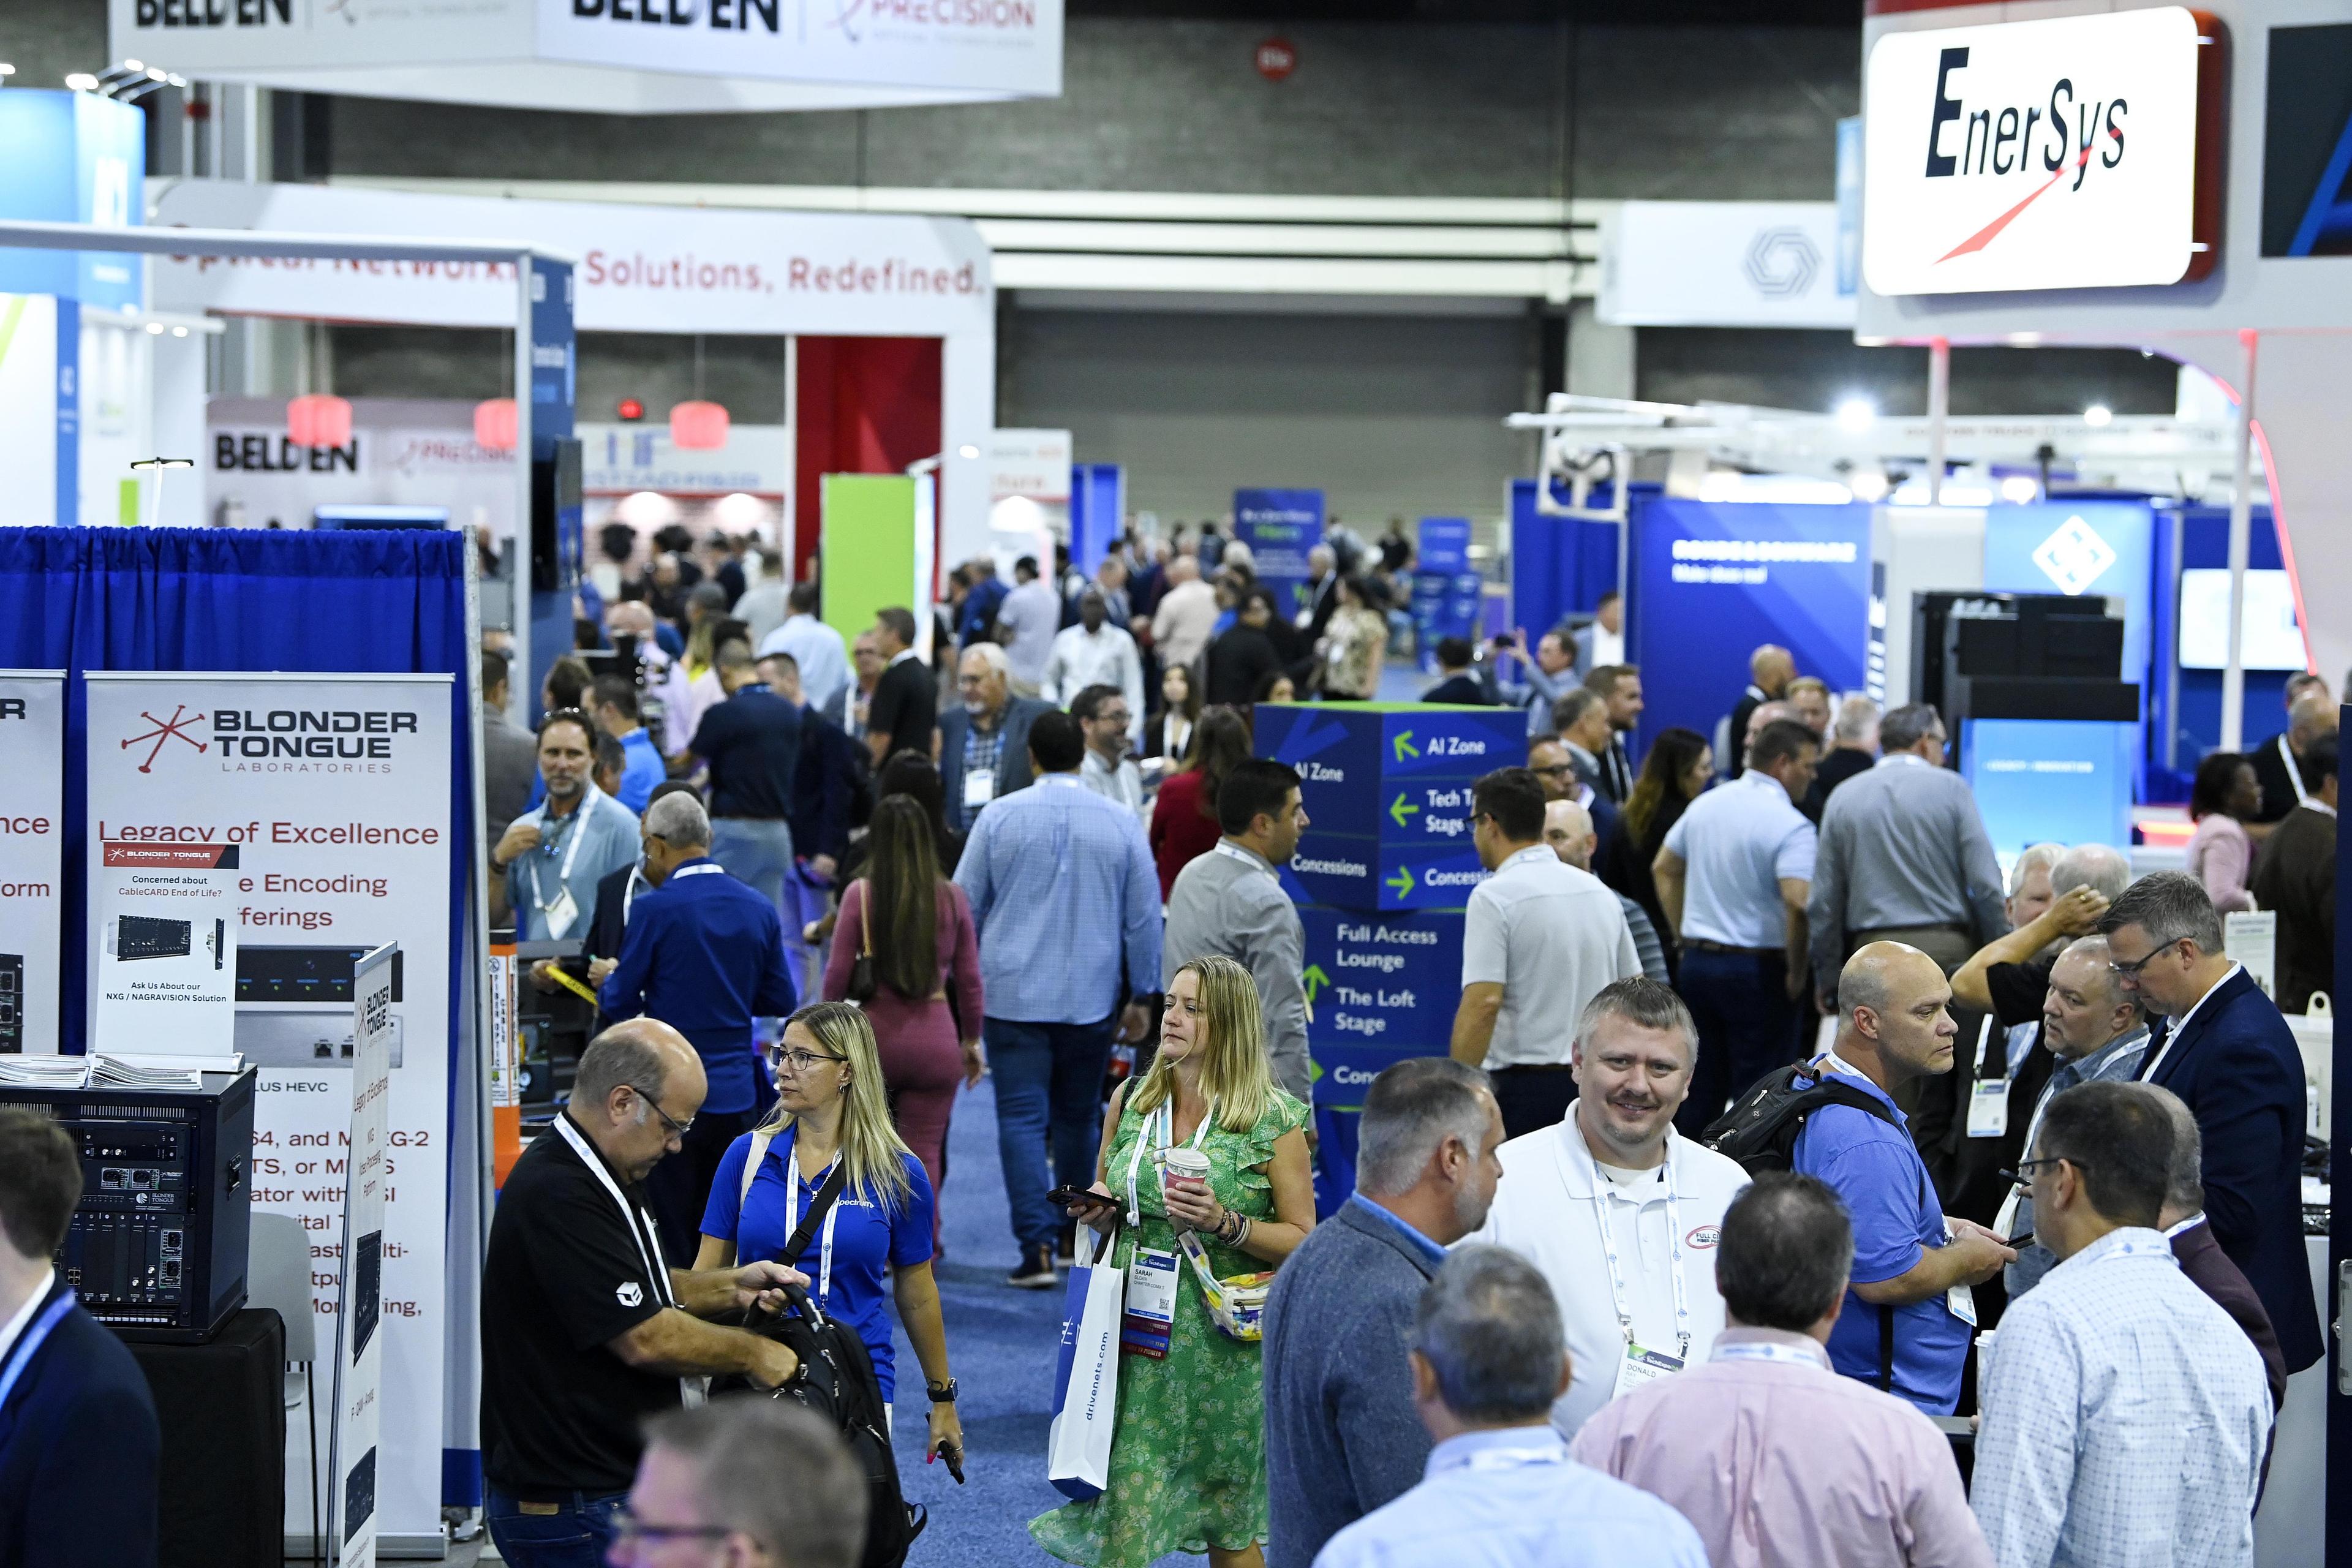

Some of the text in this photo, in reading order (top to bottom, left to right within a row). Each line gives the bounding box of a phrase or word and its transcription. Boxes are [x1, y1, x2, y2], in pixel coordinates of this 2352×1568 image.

[1925, 47, 2128, 192] EnerSys
[584, 251, 773, 295] Solutions,
[788, 255, 985, 297] Redefined.
[216, 435, 359, 472] BELDEN
[214, 710, 417, 733] BLONDER
[214, 736, 391, 758] TONGUE
[1427, 737, 1486, 755] AI Zone
[222, 763, 392, 774] LABORATORIES
[1311, 762, 1344, 783] Zone
[1426, 789, 1461, 808] Tech
[227, 821, 260, 843] of
[272, 821, 439, 845] Excellence
[1290, 853, 1367, 878] Concessions
[132, 875, 179, 884] Concerned
[265, 874, 388, 897] Encoding
[118, 888, 169, 897] CableCARD
[238, 907, 333, 930] ferings
[1336, 924, 1438, 945] Full Access
[1336, 948, 1406, 973] Lounge
[1334, 987, 1417, 1008] The Loft
[1334, 1011, 1387, 1036] Stage
[286, 1082, 328, 1092] HEVC
[289, 1131, 330, 1147] and
[295, 1162, 317, 1174] or
[302, 1186, 346, 1202] with
[838, 1199, 872, 1208] pectrum
[1135, 1268, 1153, 1277] SARAH
[1085, 1332, 1109, 1421] drivenets.com
[1627, 1363, 1656, 1378] DONALD
